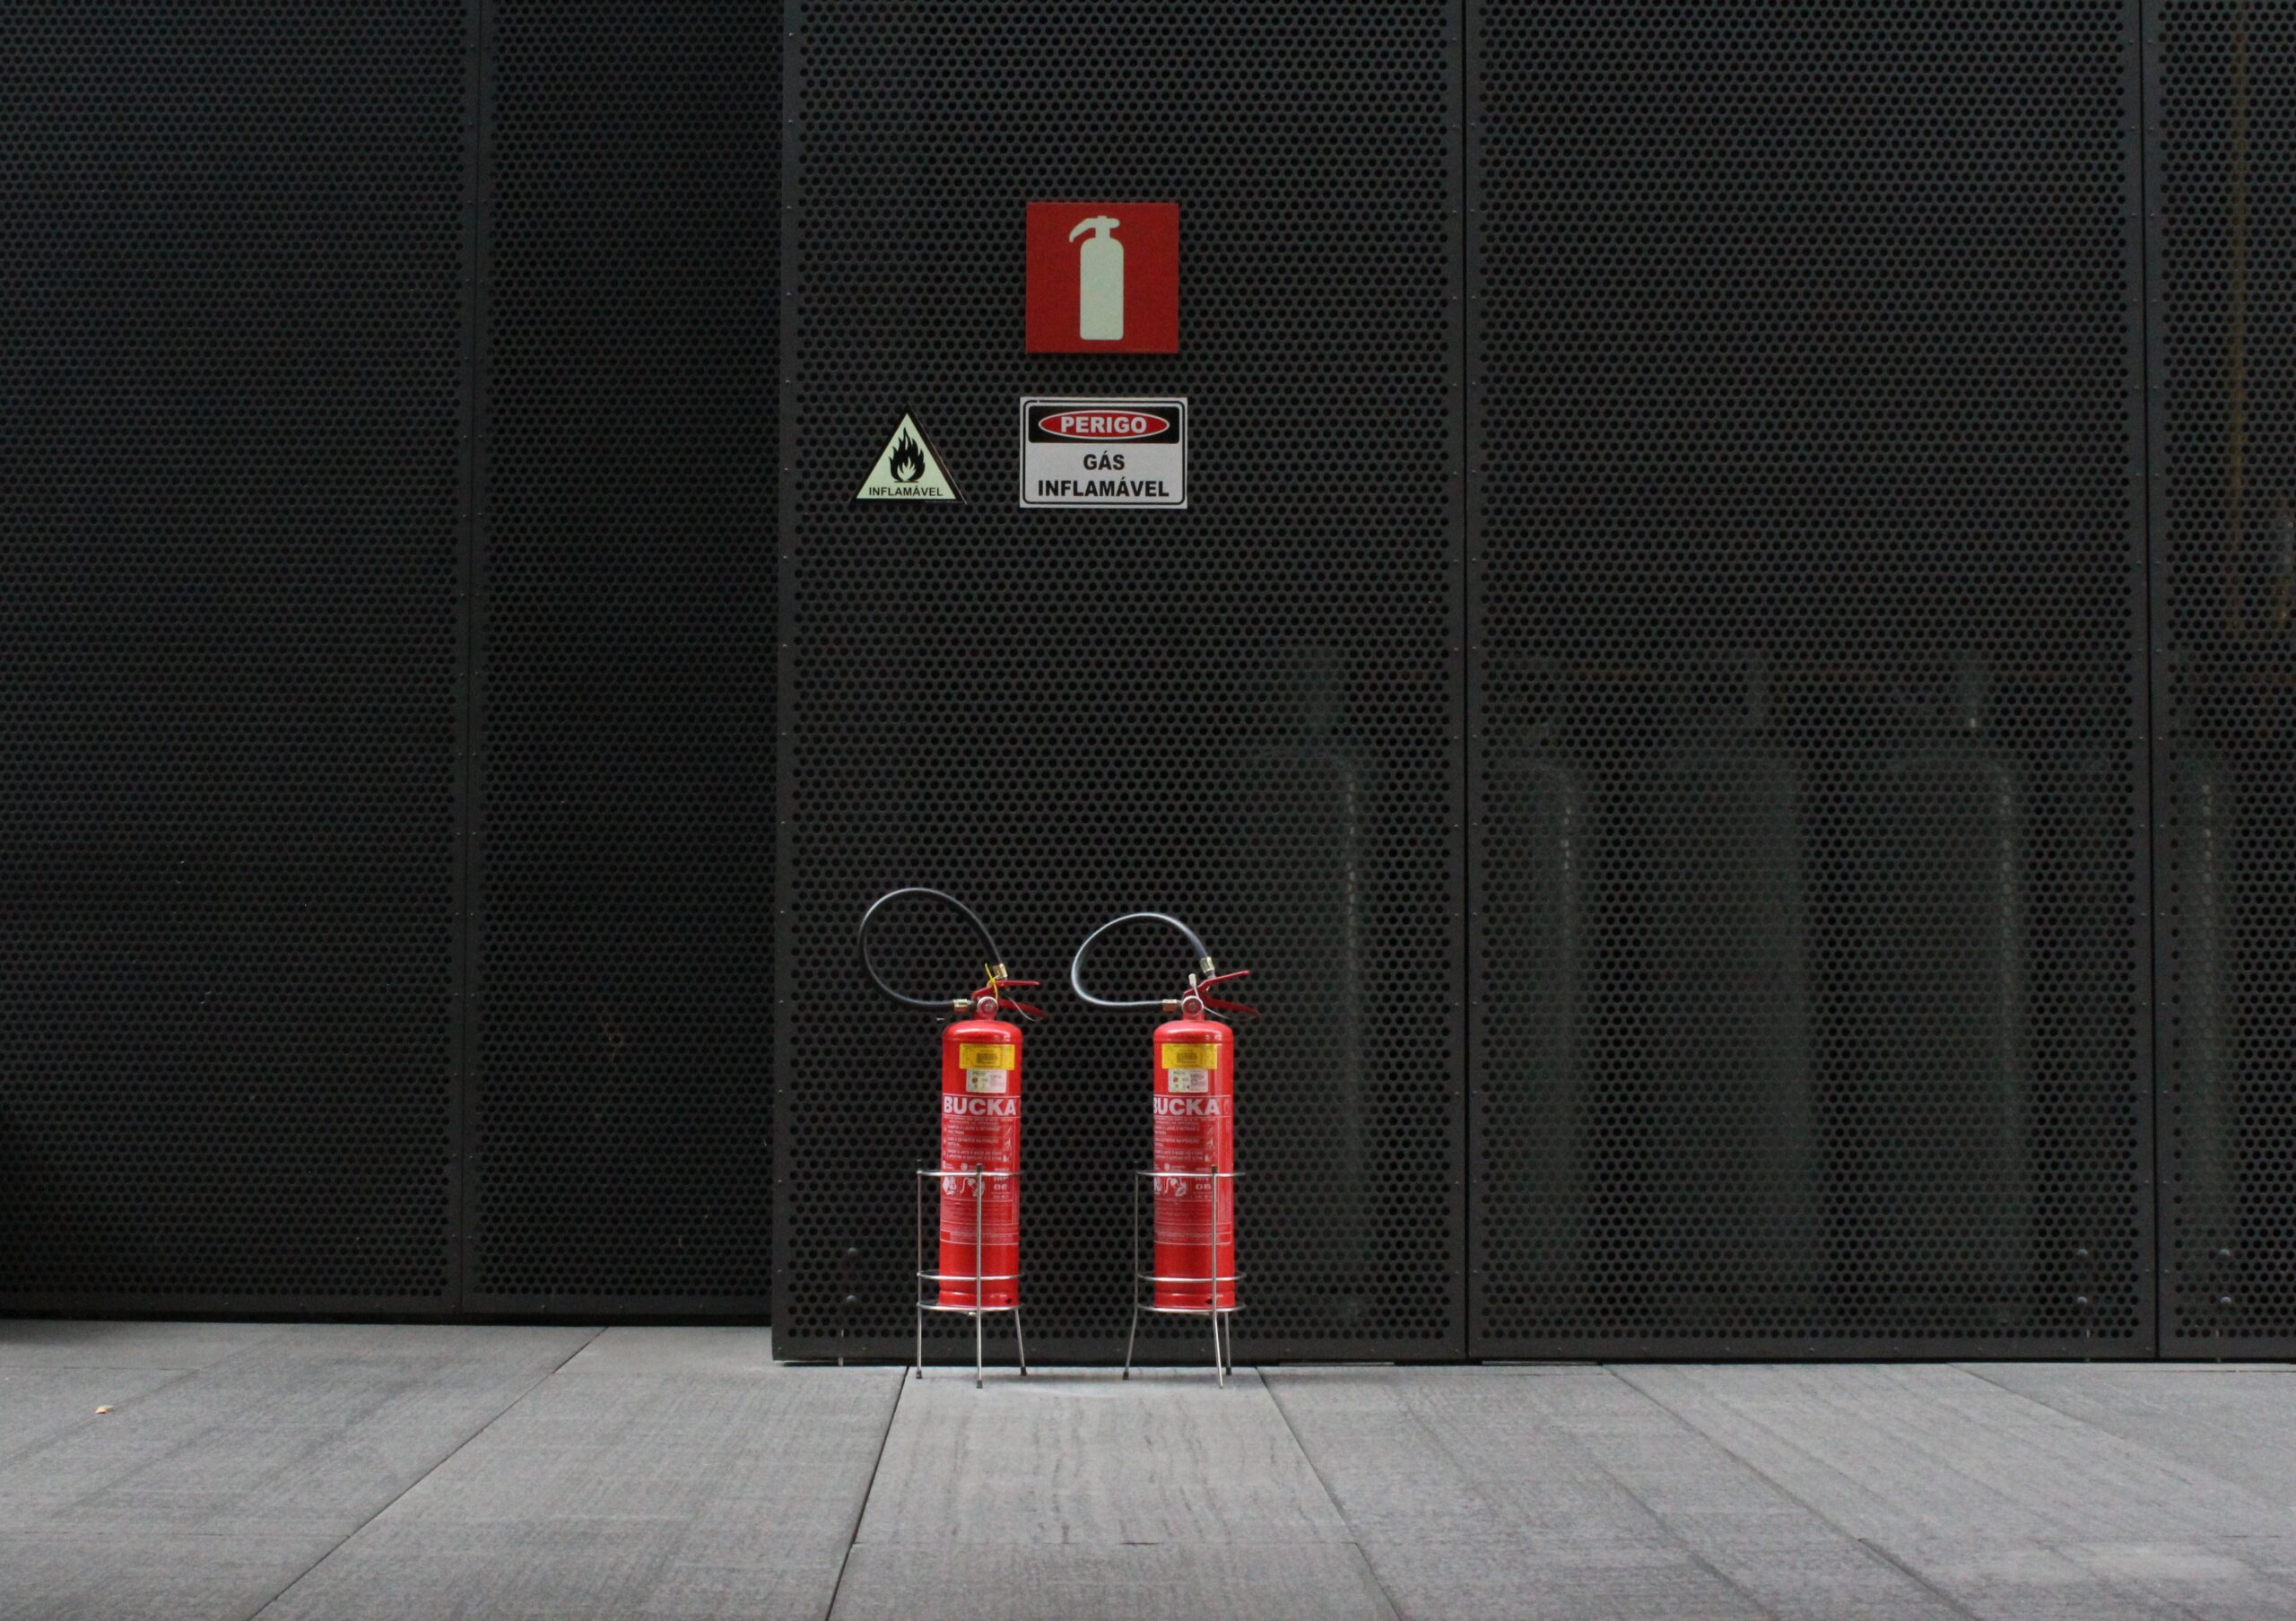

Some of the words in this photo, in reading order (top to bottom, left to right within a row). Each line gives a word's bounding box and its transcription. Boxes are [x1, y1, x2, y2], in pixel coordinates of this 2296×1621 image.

[1060, 415, 1147, 433] PERIGO
[1083, 450, 1125, 470] GÁS
[868, 484, 944, 497] INFLAMÁVEL
[1038, 476, 1170, 497] INFLAMÁVEL
[944, 1096, 1017, 1116] BUCKA
